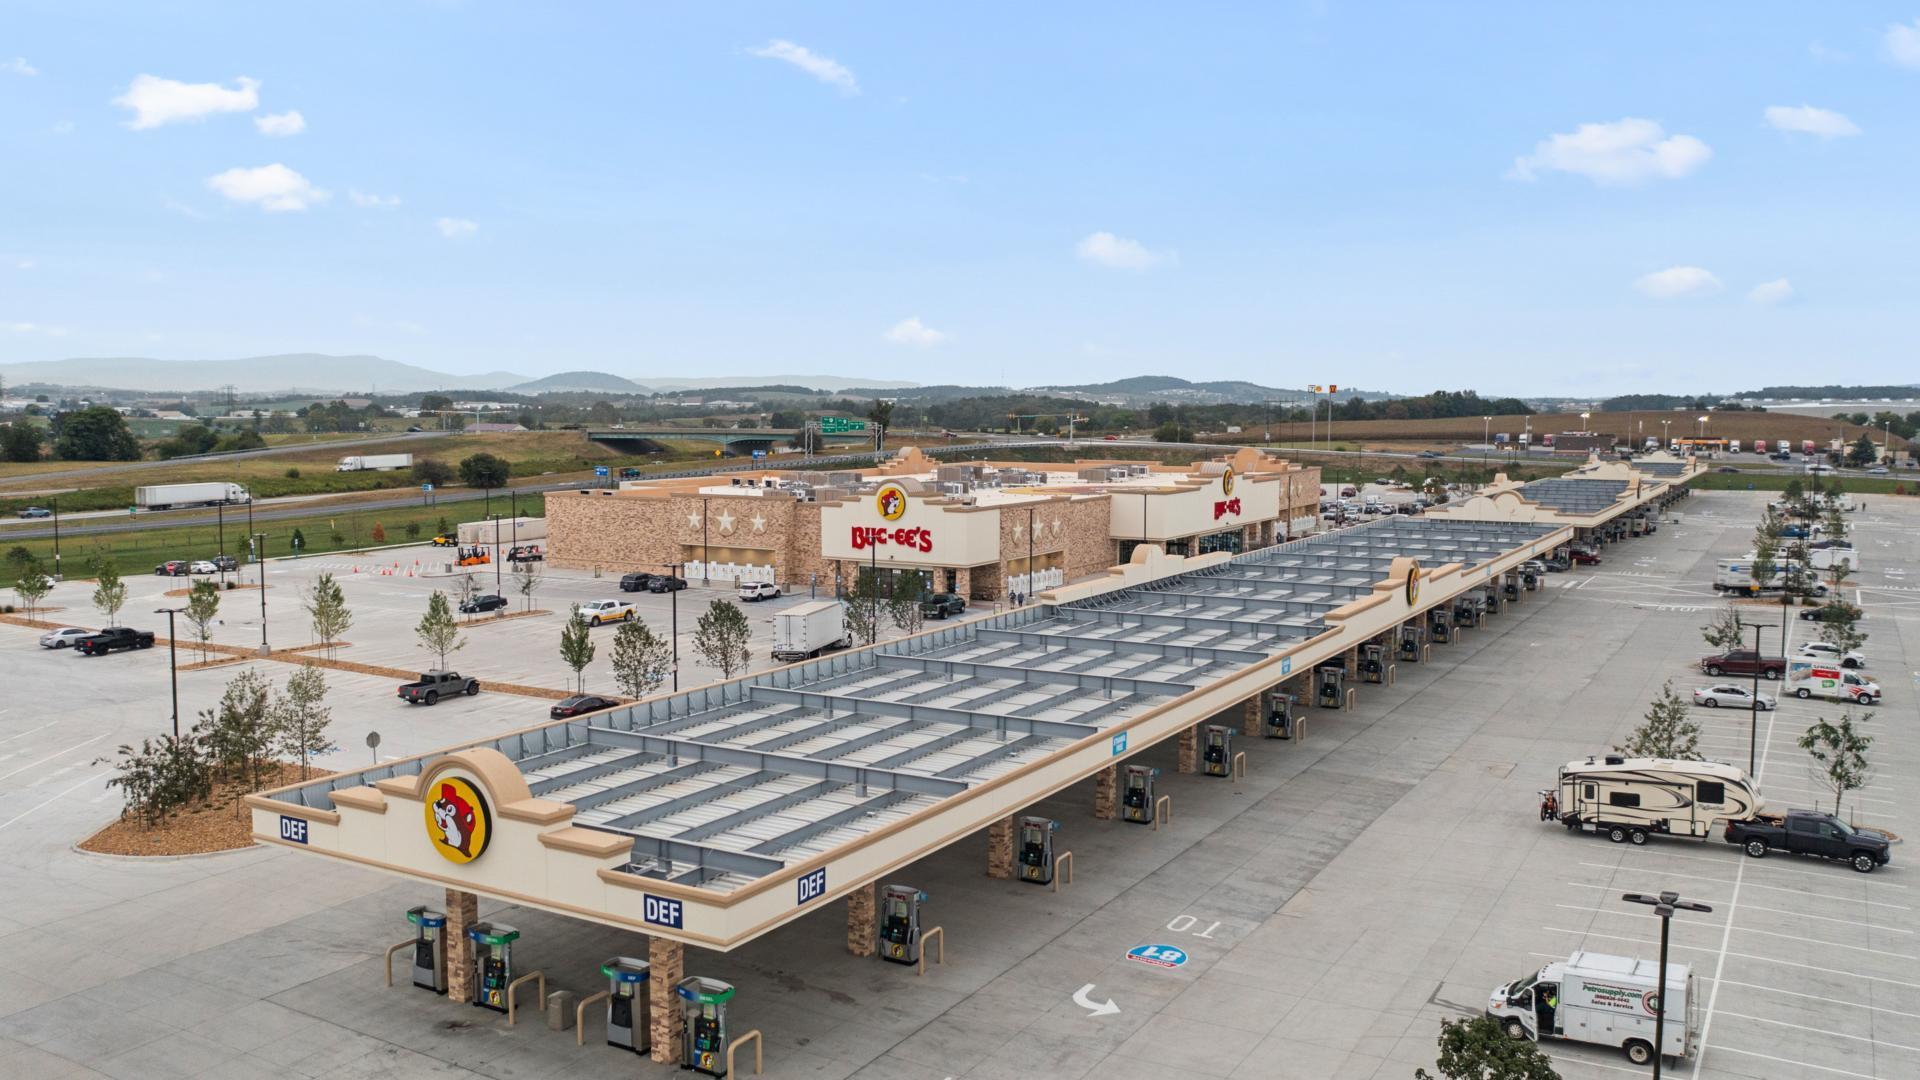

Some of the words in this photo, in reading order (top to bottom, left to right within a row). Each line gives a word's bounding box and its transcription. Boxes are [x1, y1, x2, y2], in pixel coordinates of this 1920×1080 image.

[282, 818, 306, 841] DEF
[801, 871, 824, 901] DEF
[646, 897, 680, 925] DEF
[1166, 914, 1221, 939] TO
[1141, 946, 1183, 961] 81
[1583, 984, 1642, 999] Petrosupply.com
[1613, 1002, 1634, 1010] Service
